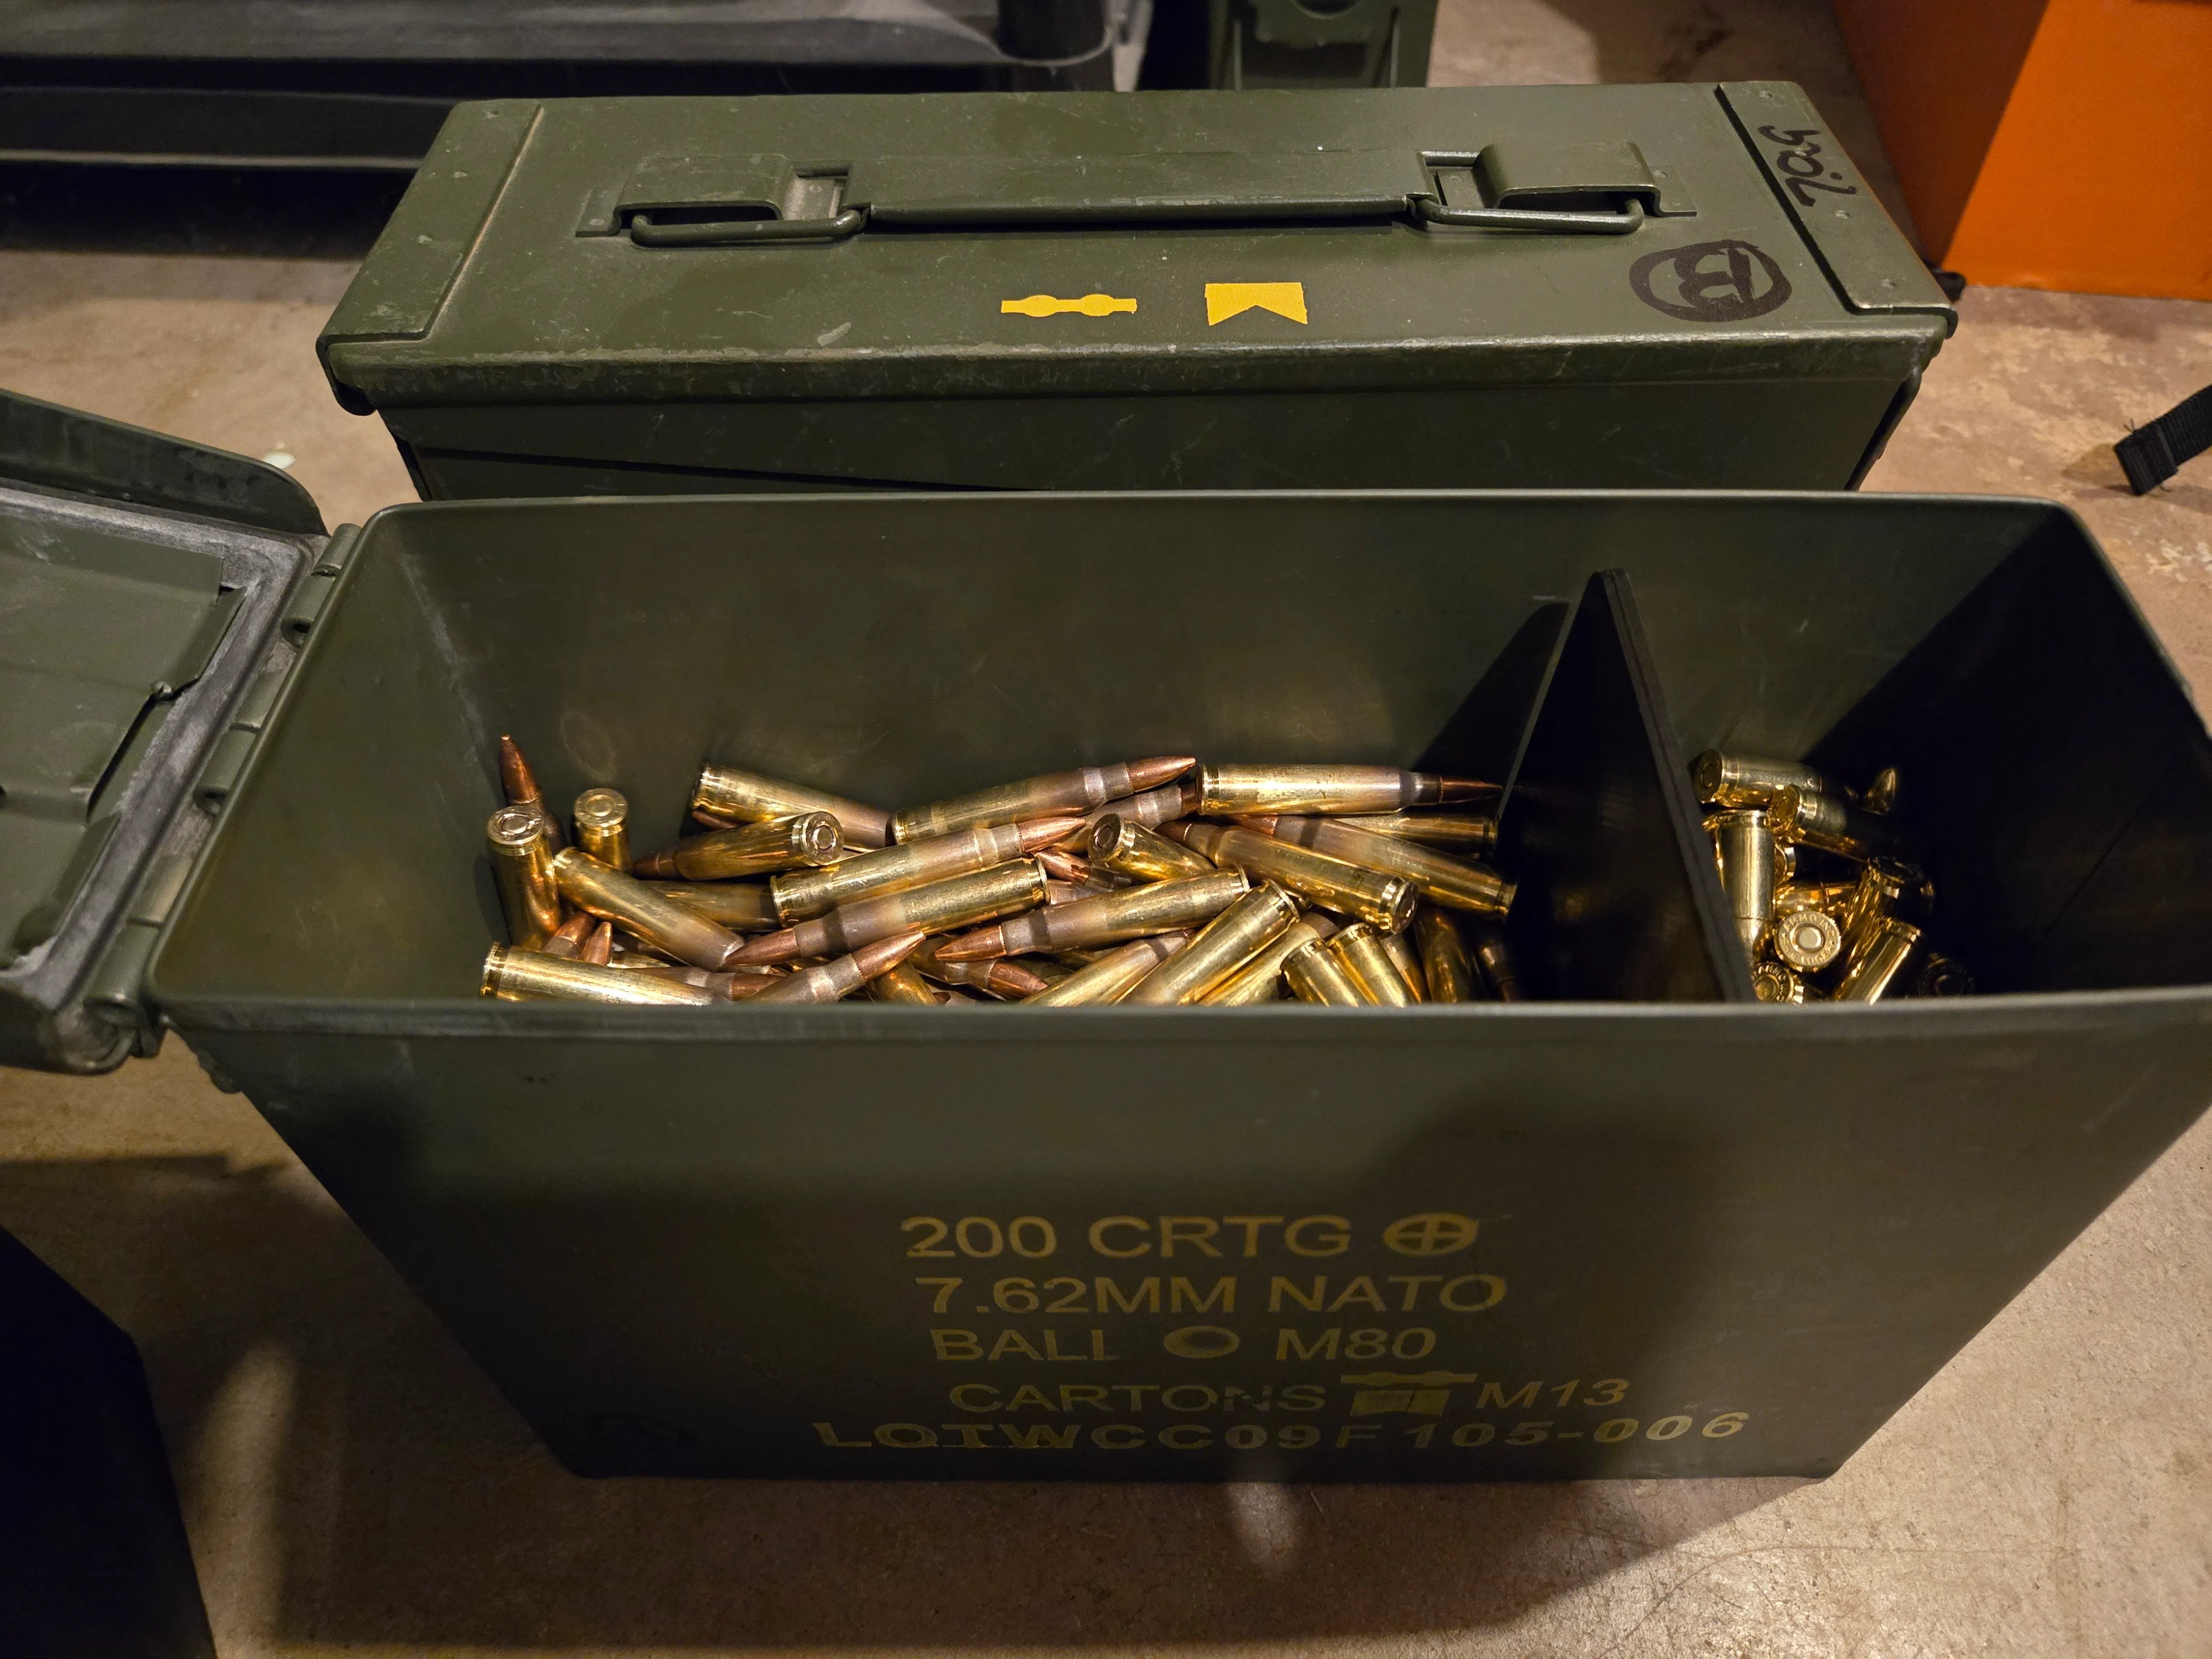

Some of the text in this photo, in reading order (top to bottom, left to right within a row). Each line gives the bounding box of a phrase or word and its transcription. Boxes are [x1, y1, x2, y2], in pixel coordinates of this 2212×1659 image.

[901, 1214, 1352, 1259] 200 CRTG
[915, 1274, 1508, 1314] 7.62MM NATO
[930, 1327, 1437, 1361] BALL M80
[950, 1378, 1631, 1412] CARTONS M13
